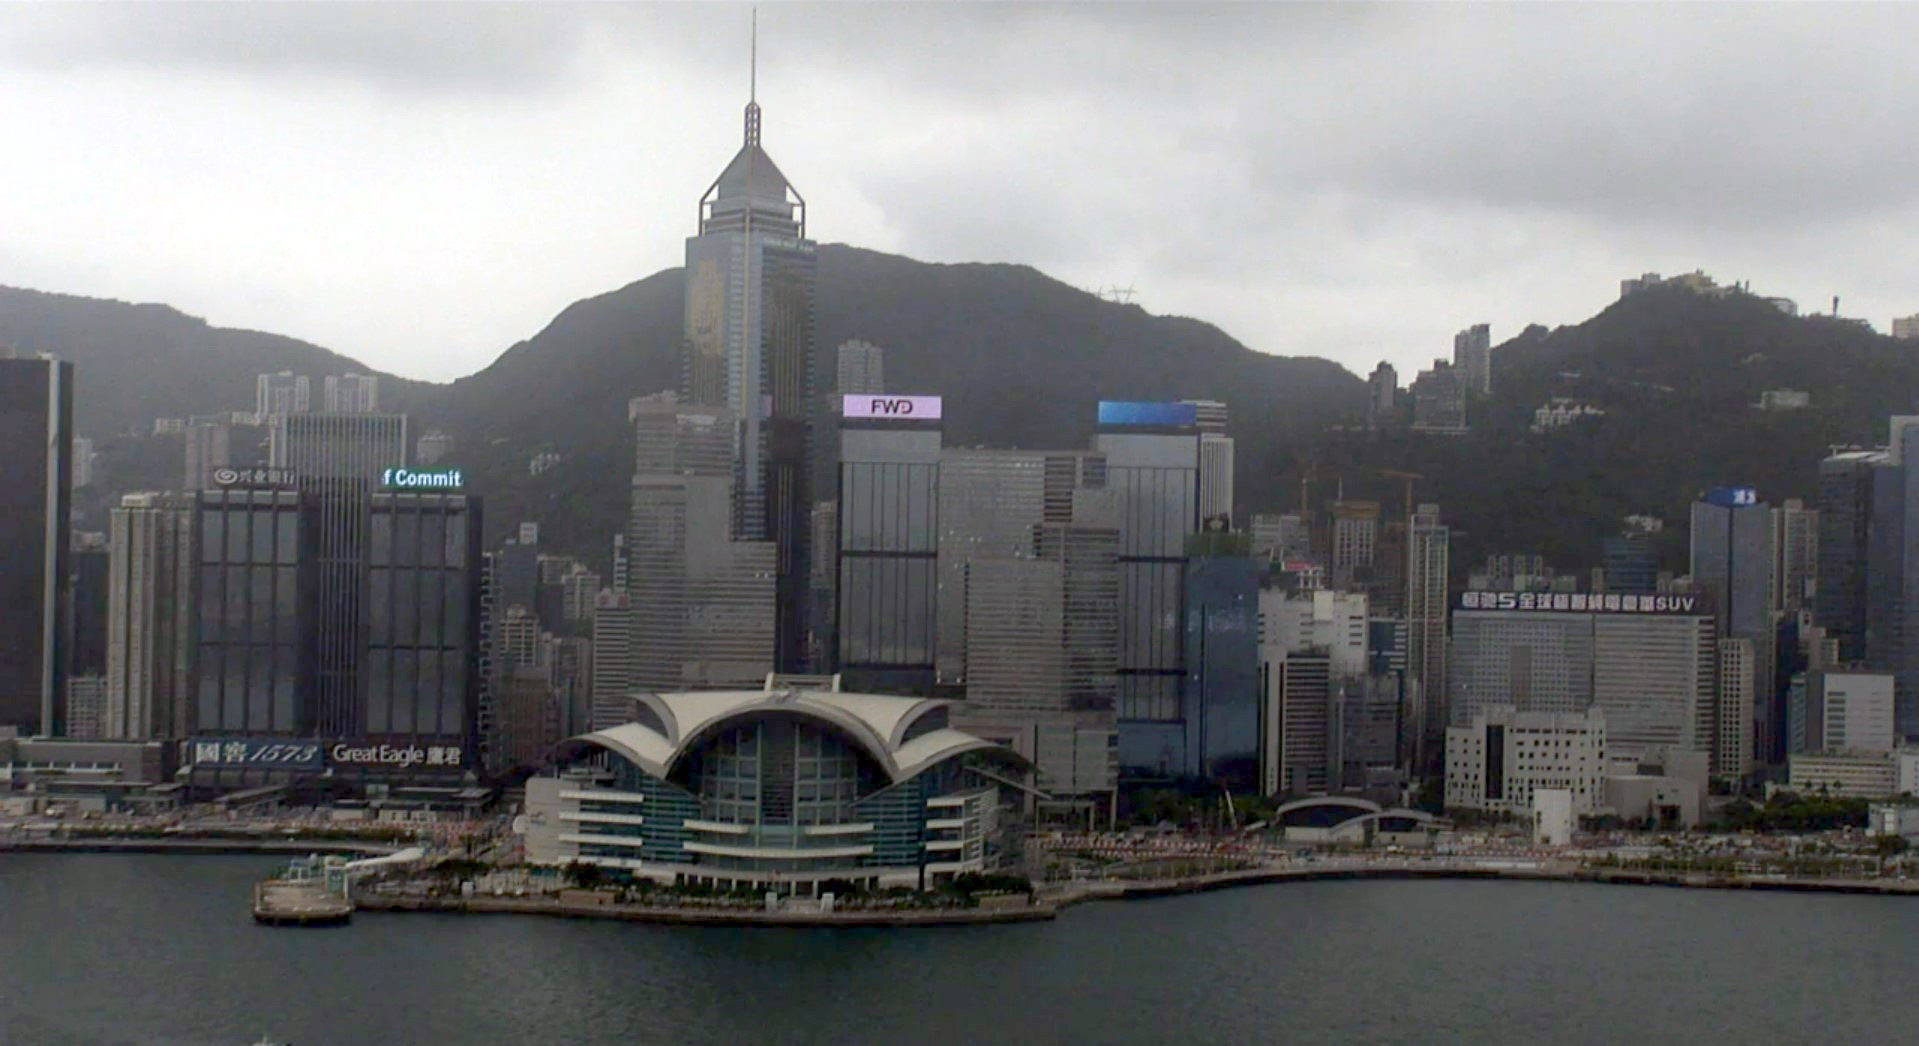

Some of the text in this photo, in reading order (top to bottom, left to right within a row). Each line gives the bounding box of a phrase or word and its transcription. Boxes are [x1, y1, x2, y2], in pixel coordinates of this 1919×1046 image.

[872, 400, 914, 414] FWD
[395, 468, 462, 486] Commit
[333, 743, 377, 762] Great
[380, 744, 424, 767] Eagle
